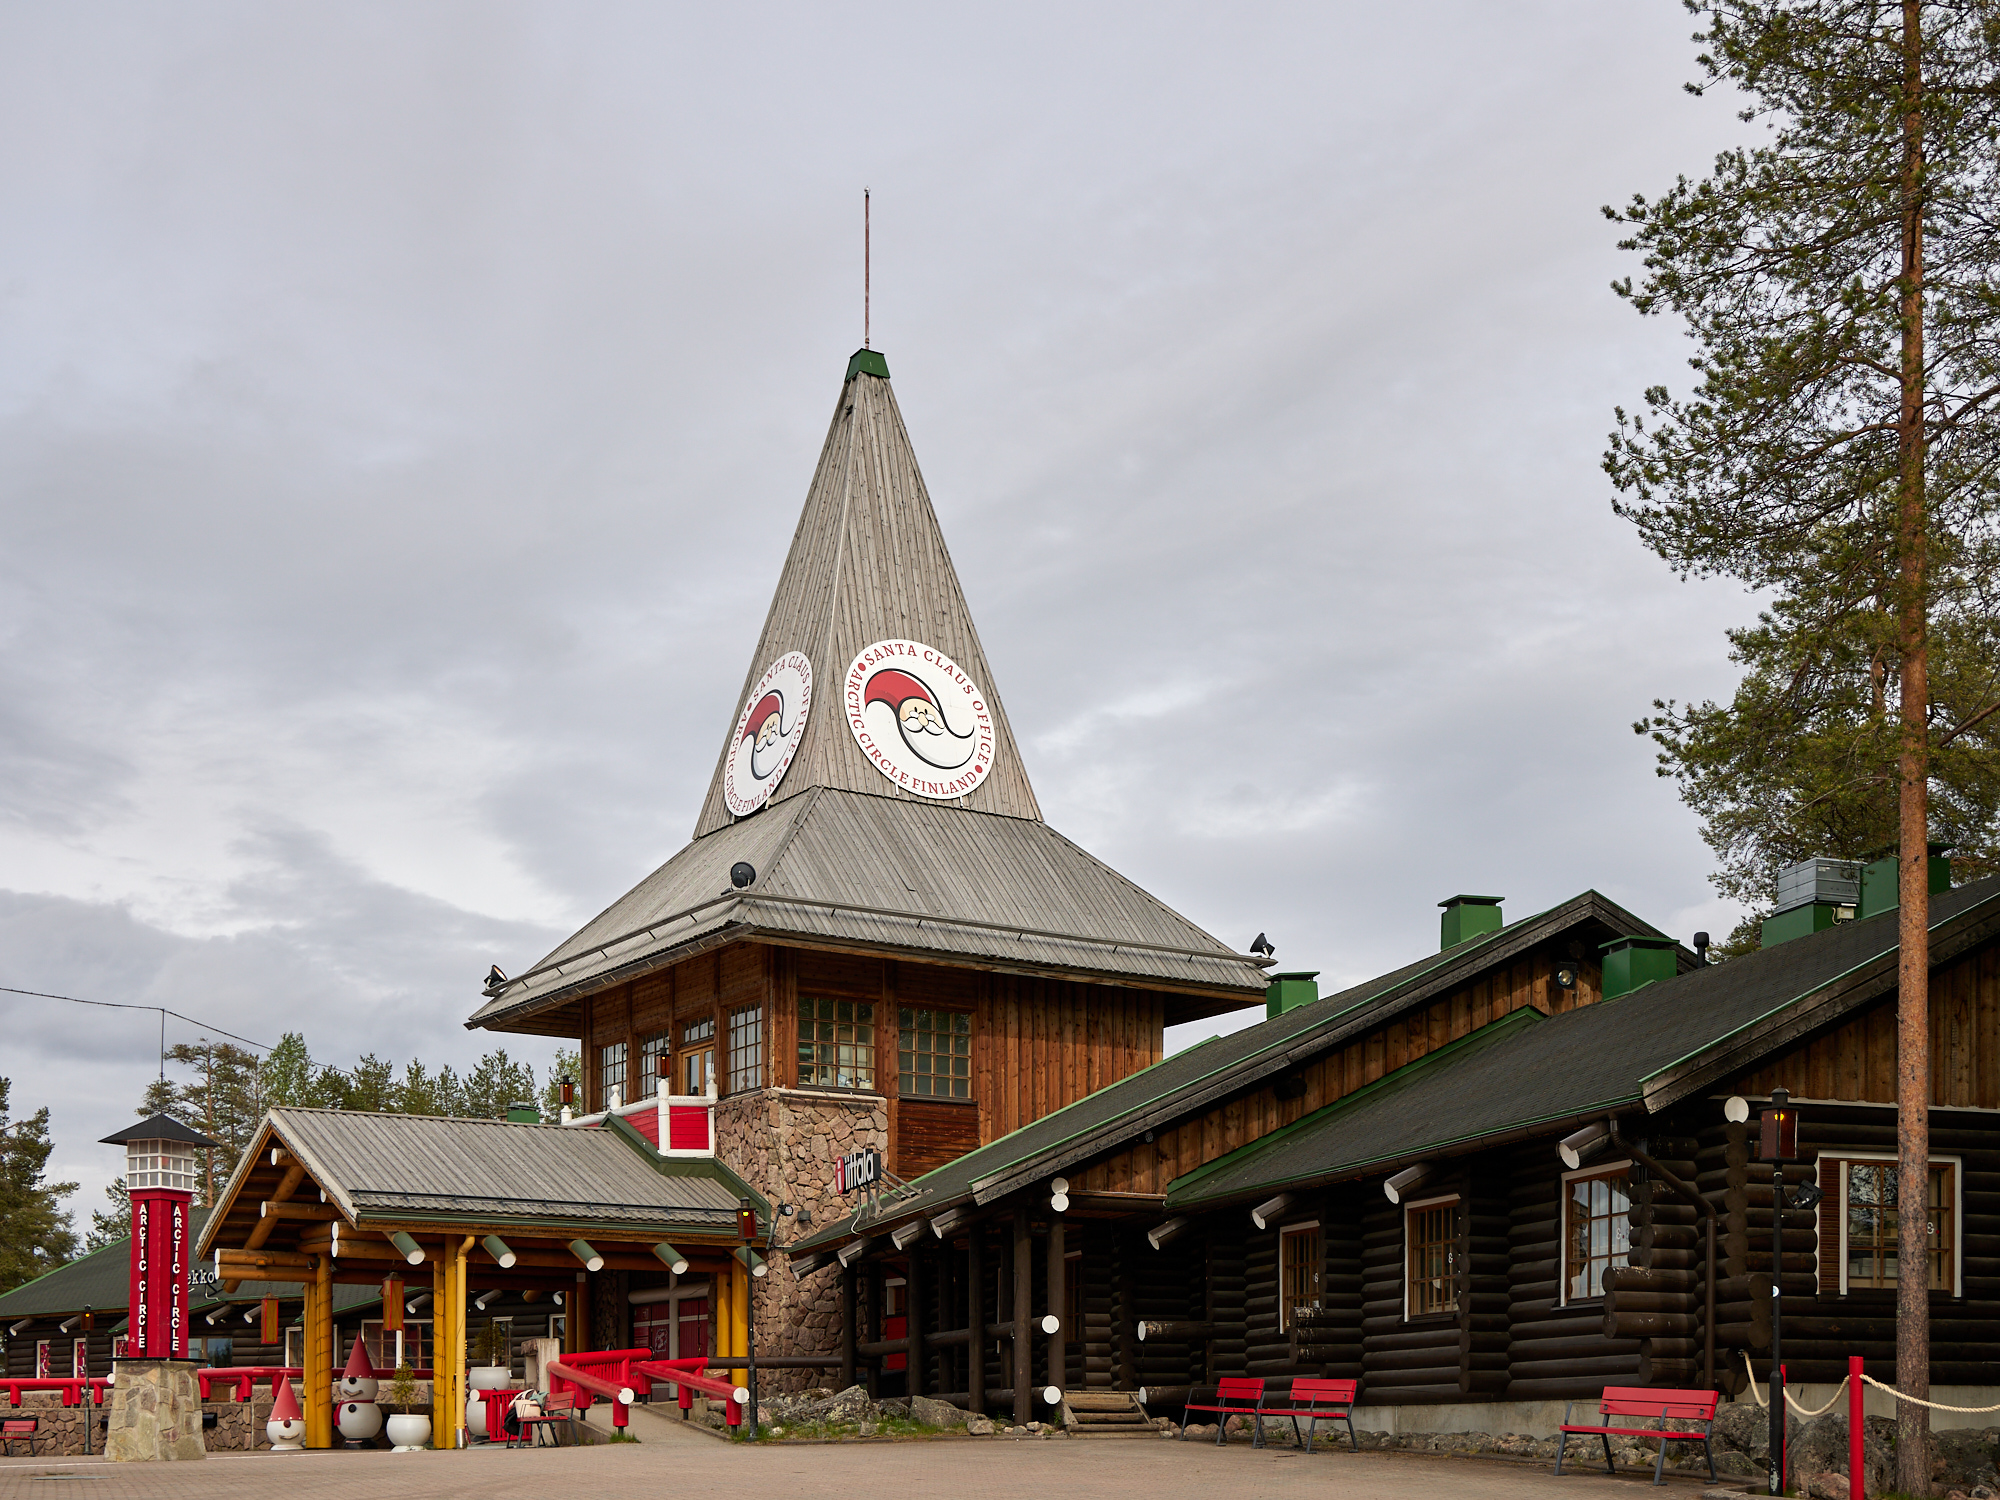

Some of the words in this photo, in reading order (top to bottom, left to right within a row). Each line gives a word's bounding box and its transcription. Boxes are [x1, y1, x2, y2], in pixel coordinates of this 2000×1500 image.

[753, 658, 786, 701] SANTA
[788, 655, 810, 684] CLAUS
[788, 685, 810, 754] OFFICE
[847, 668, 865, 730] ARCTIC
[859, 732, 909, 785] CIRCLE
[912, 770, 978, 795] FINLAND
[864, 643, 918, 666] SANTA
[923, 650, 974, 695] CLAUS
[972, 700, 993, 765] OFFICE
[726, 714, 748, 775] ARCTIC
[726, 776, 742, 812] CIRCLE
[741, 768, 784, 813] FINLAND
[844, 1147, 874, 1191] iittala
[138, 1203, 148, 1272] ARCTIC
[172, 1205, 183, 1274] ARCTIC
[187, 1268, 215, 1285] ekko
[138, 1280, 147, 1349] CIRCLE
[171, 1283, 180, 1351] CIRCLE
